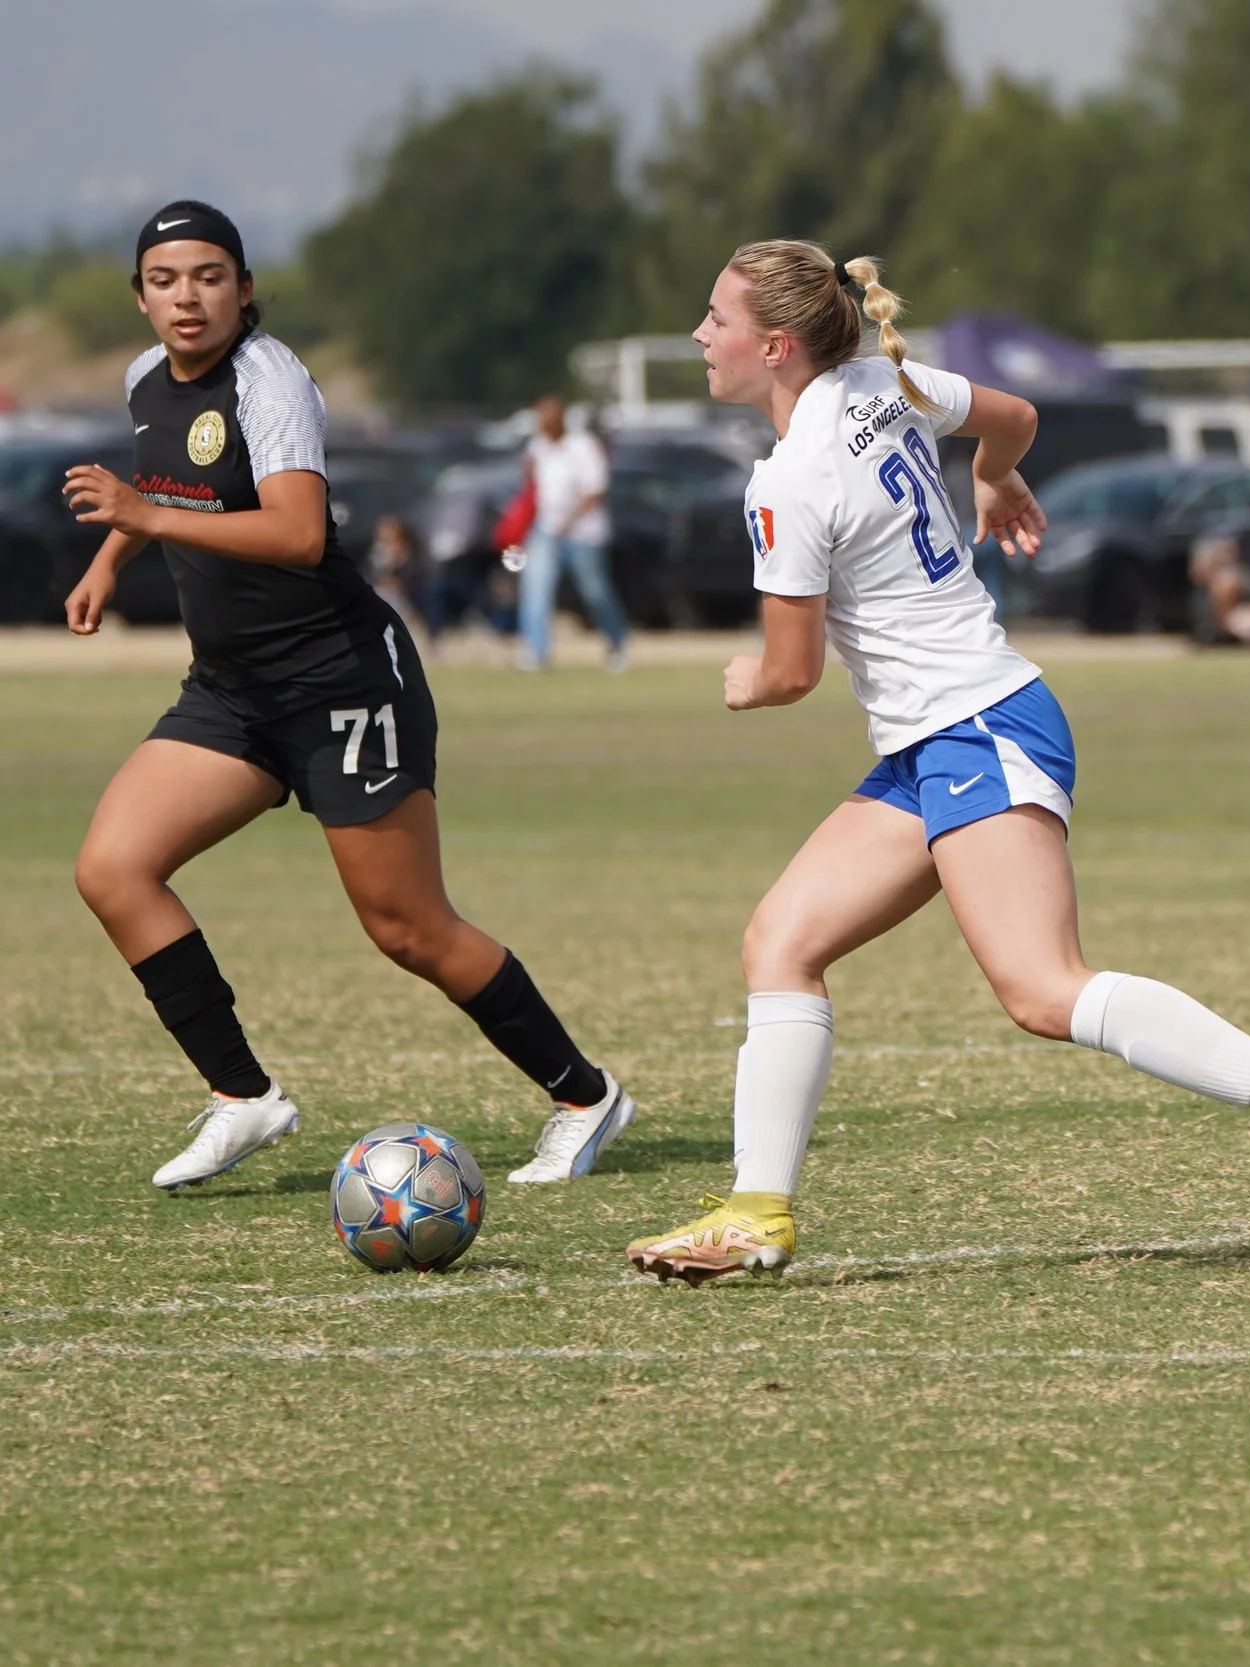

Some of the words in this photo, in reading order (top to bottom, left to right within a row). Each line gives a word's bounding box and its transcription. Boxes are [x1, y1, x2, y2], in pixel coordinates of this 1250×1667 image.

[847, 425, 875, 457] LOS
[137, 491, 224, 512] ANSMISSION
[329, 703, 399, 775] 71
